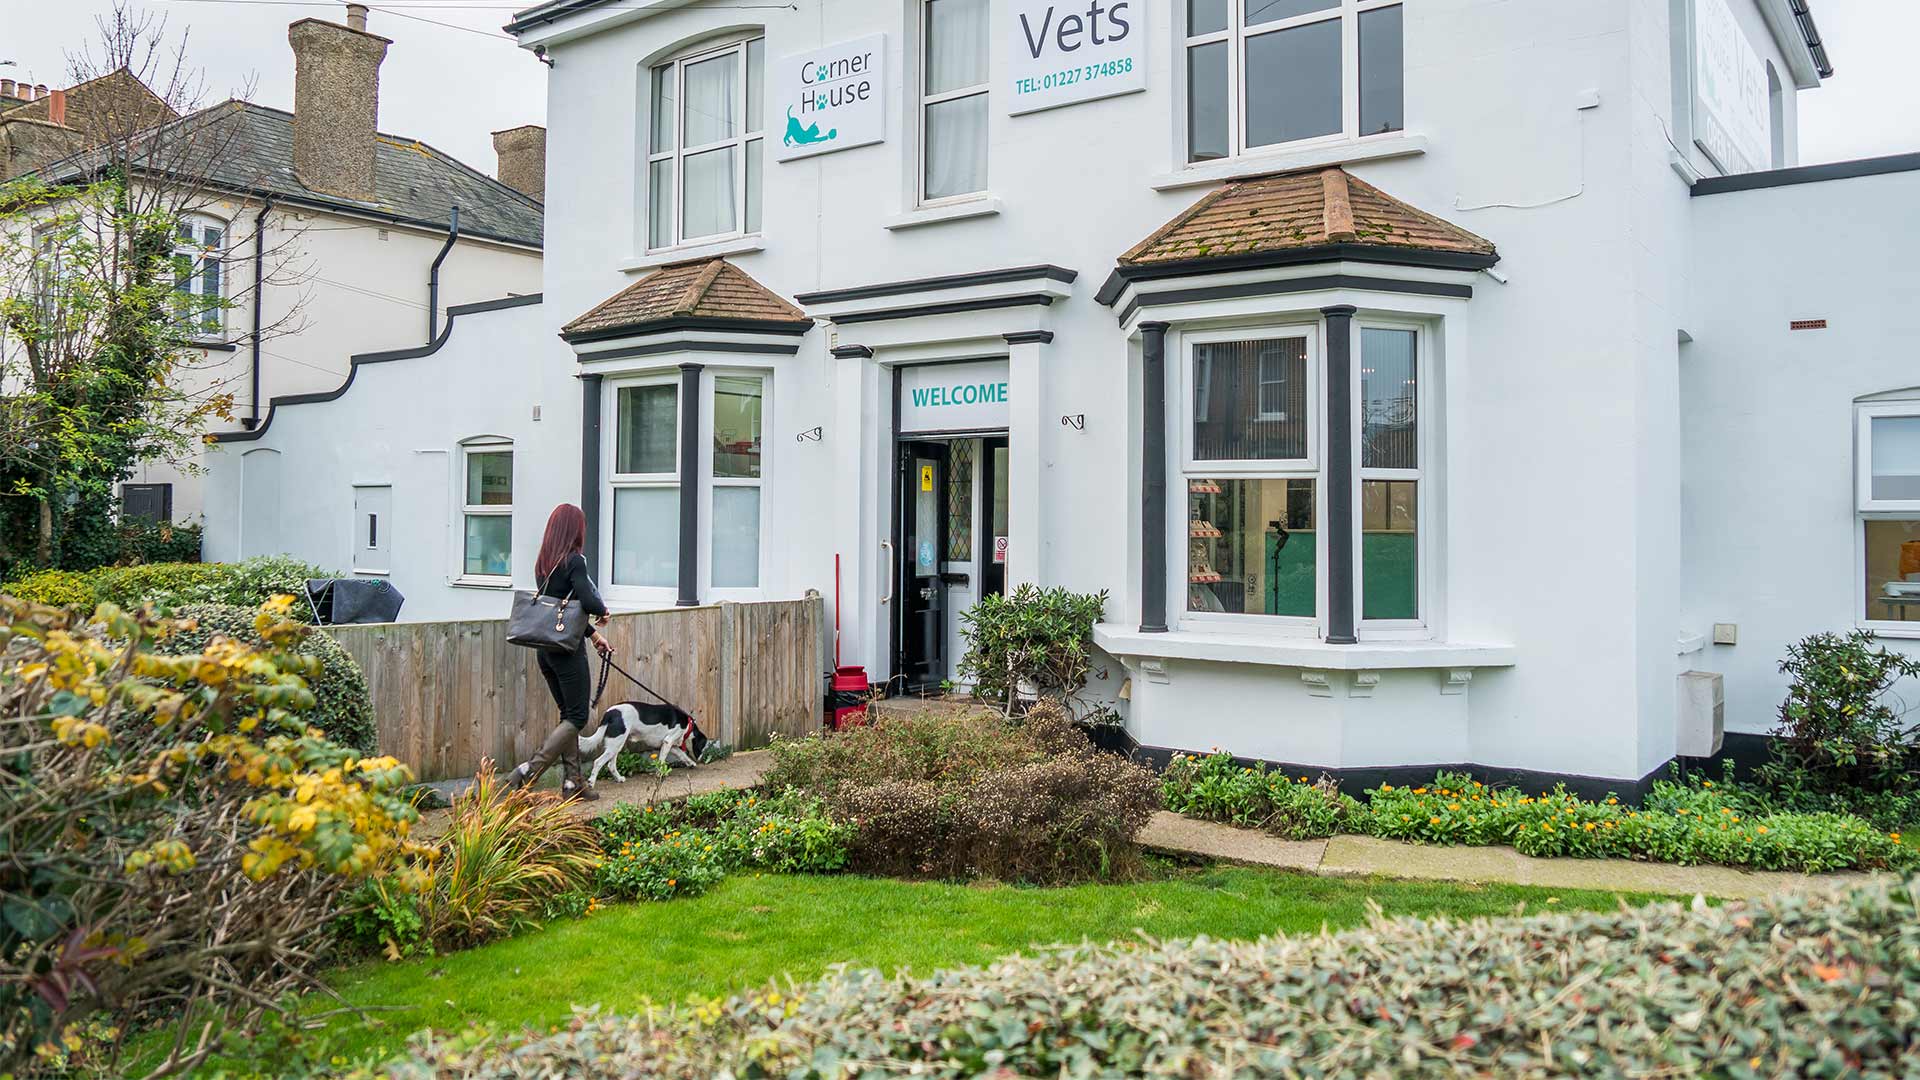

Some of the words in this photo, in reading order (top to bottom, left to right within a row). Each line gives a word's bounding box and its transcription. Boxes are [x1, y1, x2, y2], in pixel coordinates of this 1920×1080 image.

[1019, 0, 1130, 59] Vets
[1016, 78, 1041, 95] TEL:
[1044, 68, 1082, 89] 01227
[1085, 57, 1133, 81] 374858
[912, 382, 1008, 408] WELCOME
